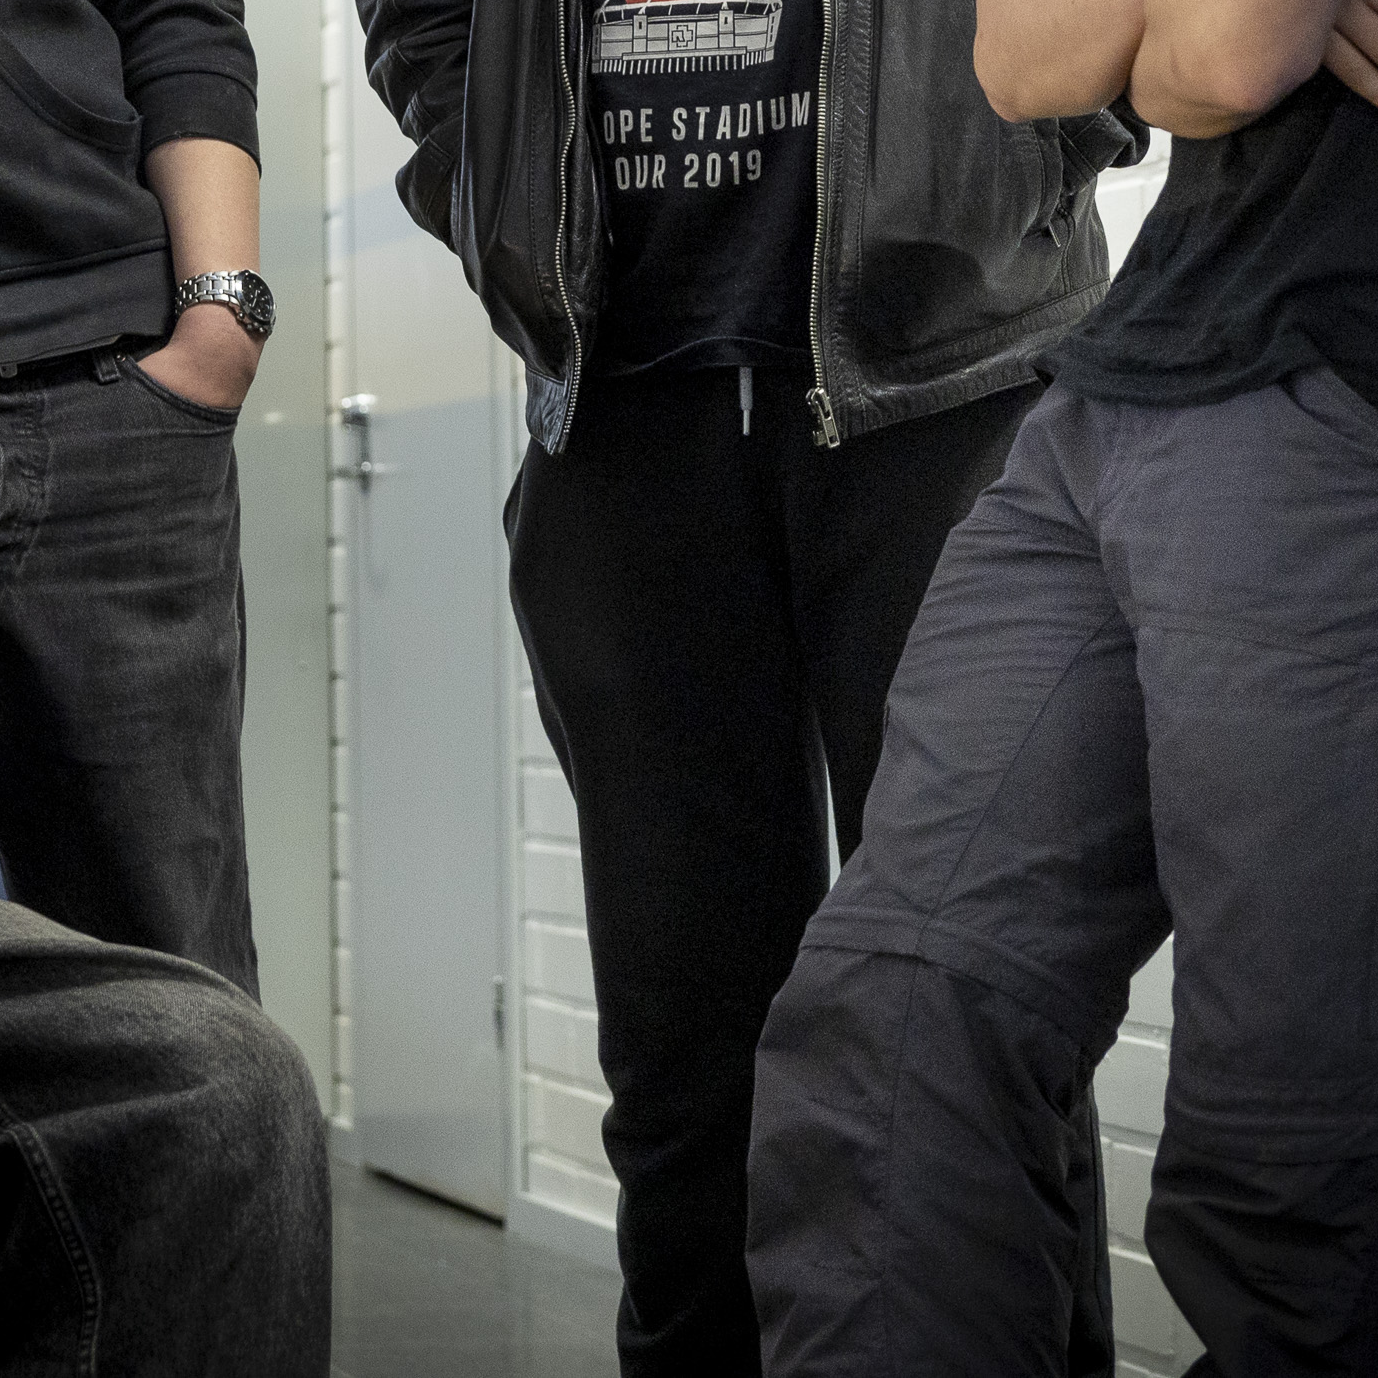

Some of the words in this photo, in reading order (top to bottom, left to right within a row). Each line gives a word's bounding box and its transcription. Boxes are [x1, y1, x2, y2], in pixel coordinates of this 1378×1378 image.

[603, 108, 653, 145] OPE
[672, 91, 811, 141] STADIUM
[614, 154, 666, 190] OUR
[683, 149, 762, 189] 2019
